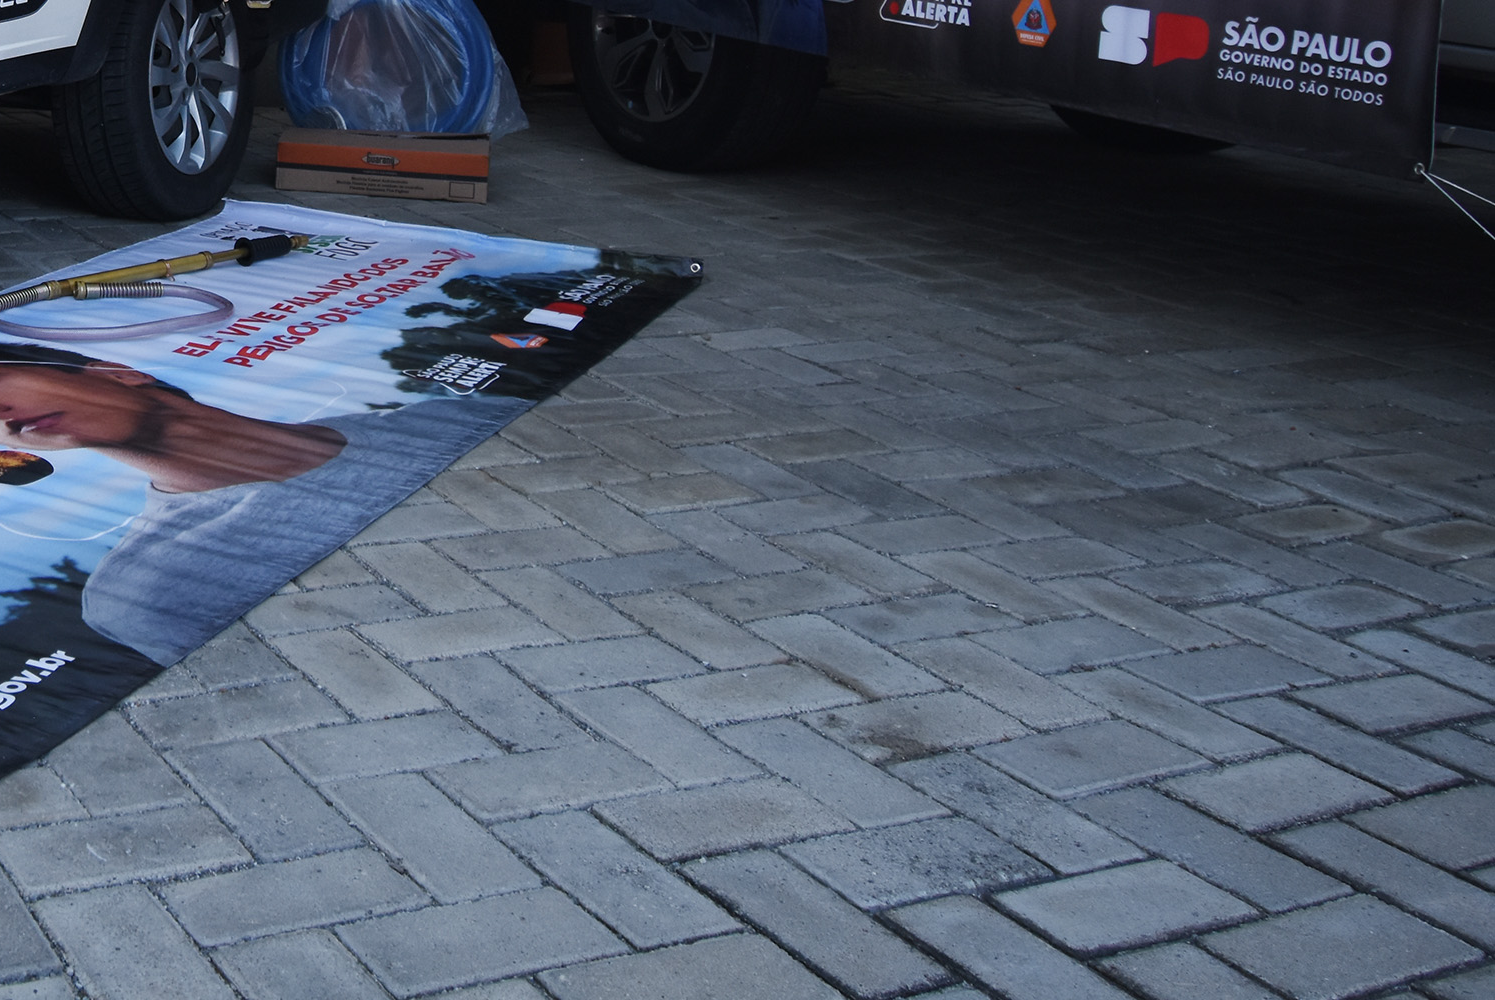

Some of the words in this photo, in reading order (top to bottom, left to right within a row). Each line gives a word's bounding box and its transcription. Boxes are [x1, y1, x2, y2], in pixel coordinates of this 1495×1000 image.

[901, 0, 971, 26] ALERTA
[1222, 16, 1285, 52] SÃO
[1291, 30, 1392, 68] PAULO
[1217, 66, 1245, 83] SÃO
[1250, 74, 1294, 91] PAULO
[1299, 79, 1329, 97] SÃO
[1334, 88, 1383, 106] TODOS
[1219, 50, 1295, 71] GOVERNO
[1300, 60, 1323, 76] DO
[1327, 66, 1388, 86] ESTADO
[216, 311, 287, 336] VIVE
[358, 258, 409, 277] DOS
